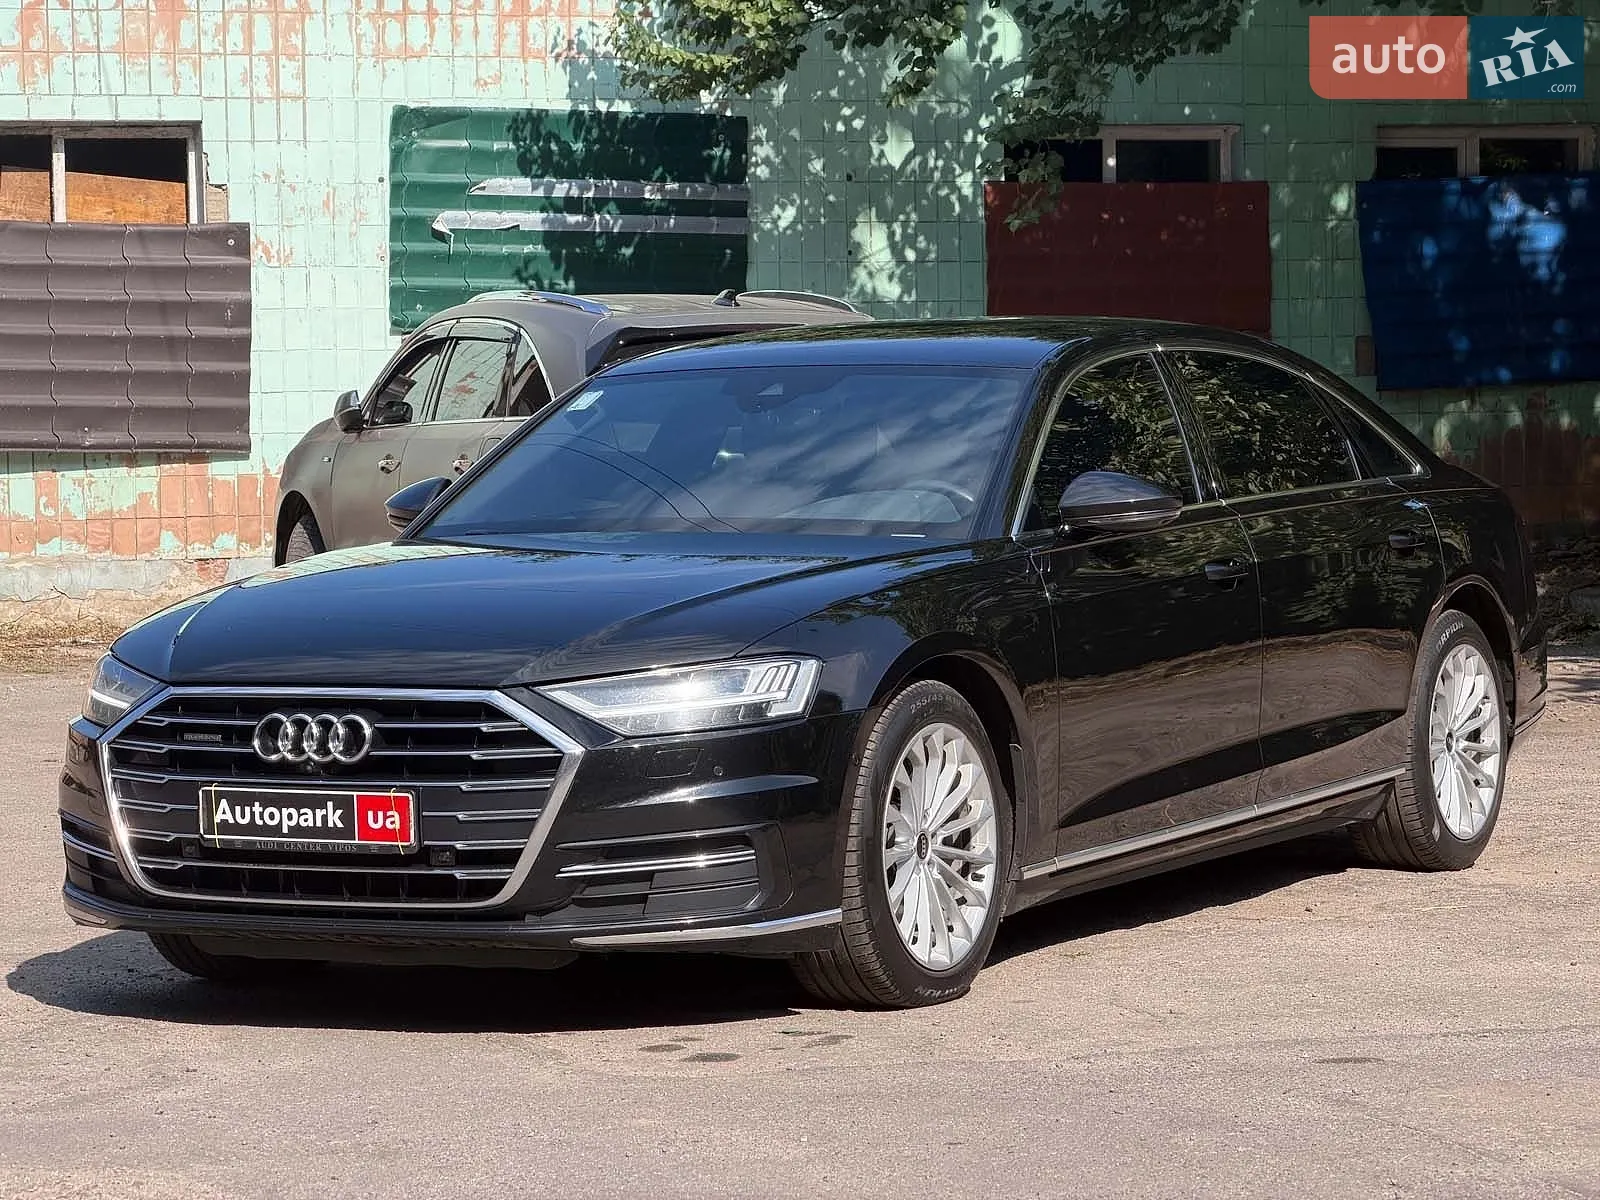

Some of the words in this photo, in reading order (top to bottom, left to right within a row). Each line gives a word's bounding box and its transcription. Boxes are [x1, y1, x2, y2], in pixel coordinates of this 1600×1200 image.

[215, 798, 345, 834] Autopark
[367, 809, 401, 830] ua
[255, 840, 278, 849] AUDI
[283, 841, 322, 851] CENTER
